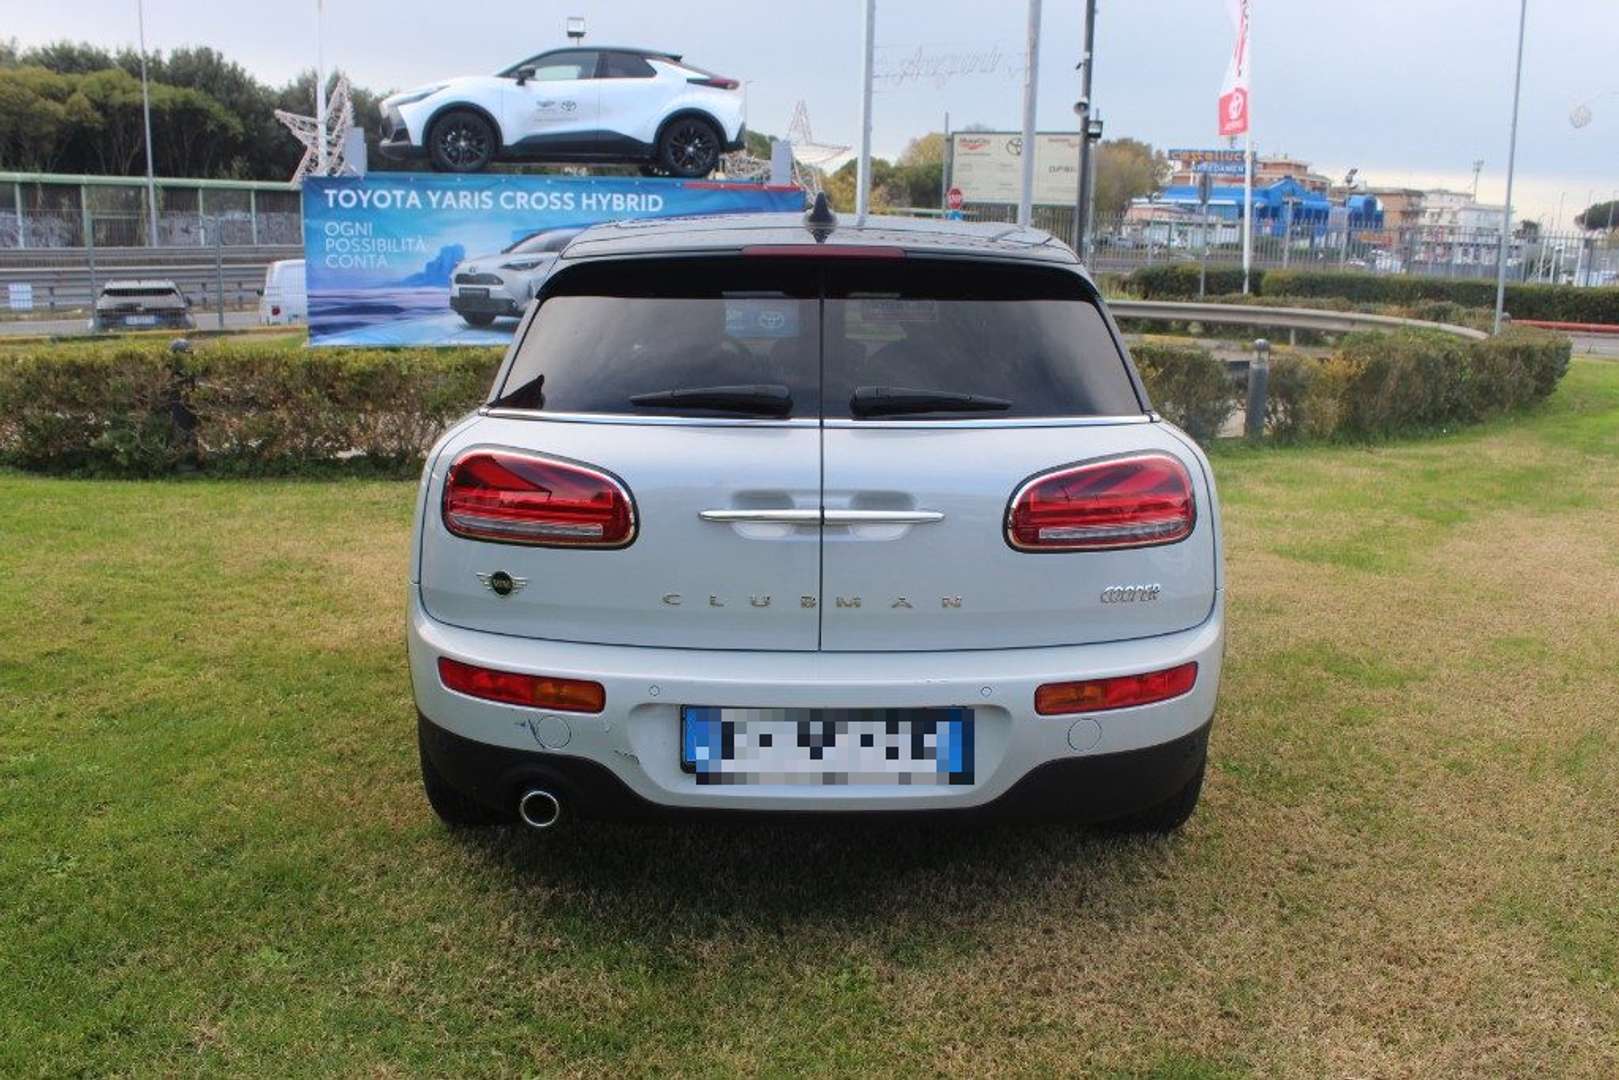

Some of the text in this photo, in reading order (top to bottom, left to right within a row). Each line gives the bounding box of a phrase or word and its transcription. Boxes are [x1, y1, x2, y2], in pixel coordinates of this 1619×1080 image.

[324, 189, 664, 212] TOYOTA YARIS CROSS HYBRID
[324, 221, 373, 237] OGNI
[325, 235, 426, 252] POSSIBILITÀ
[325, 253, 389, 268] CONTA
